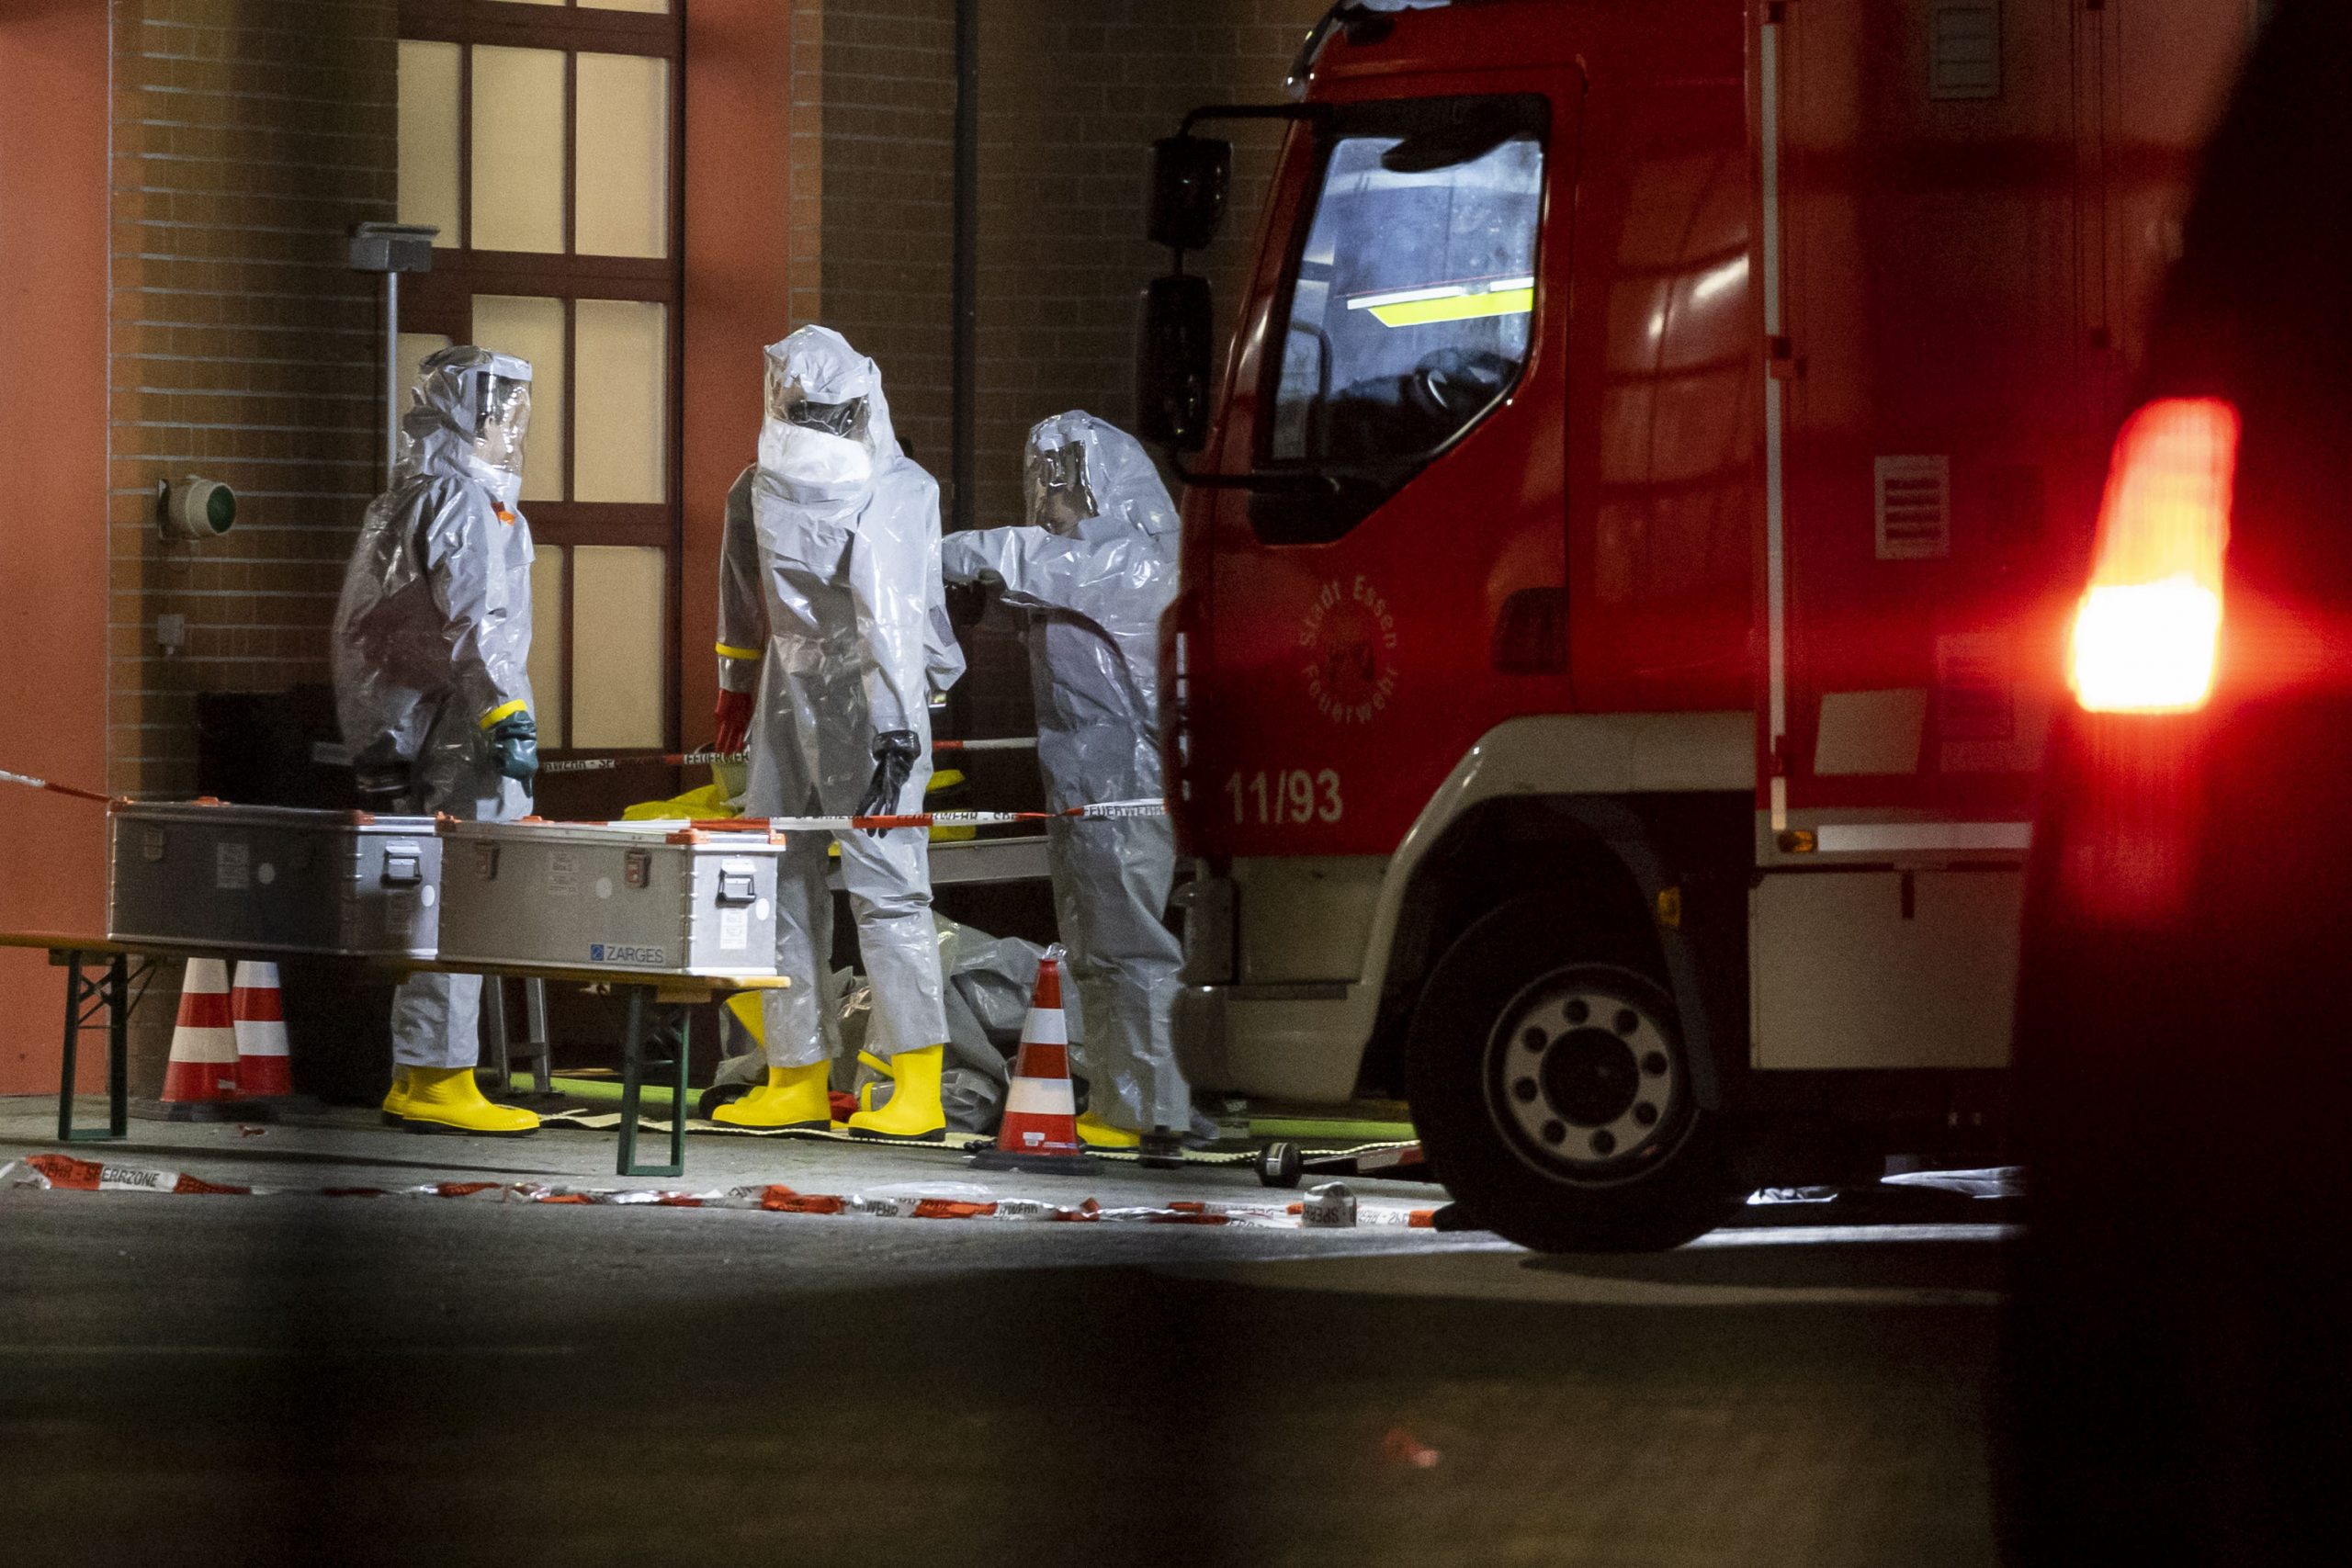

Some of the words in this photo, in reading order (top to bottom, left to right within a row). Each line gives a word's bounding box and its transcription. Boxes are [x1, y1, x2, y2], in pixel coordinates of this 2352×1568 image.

[1299, 580, 1340, 648] Stadt
[1352, 575, 1397, 649] Essen
[1225, 768, 1344, 825] 11/93
[606, 946, 663, 964] ZARGES
[83, 1164, 160, 1188] SPERRZONE
